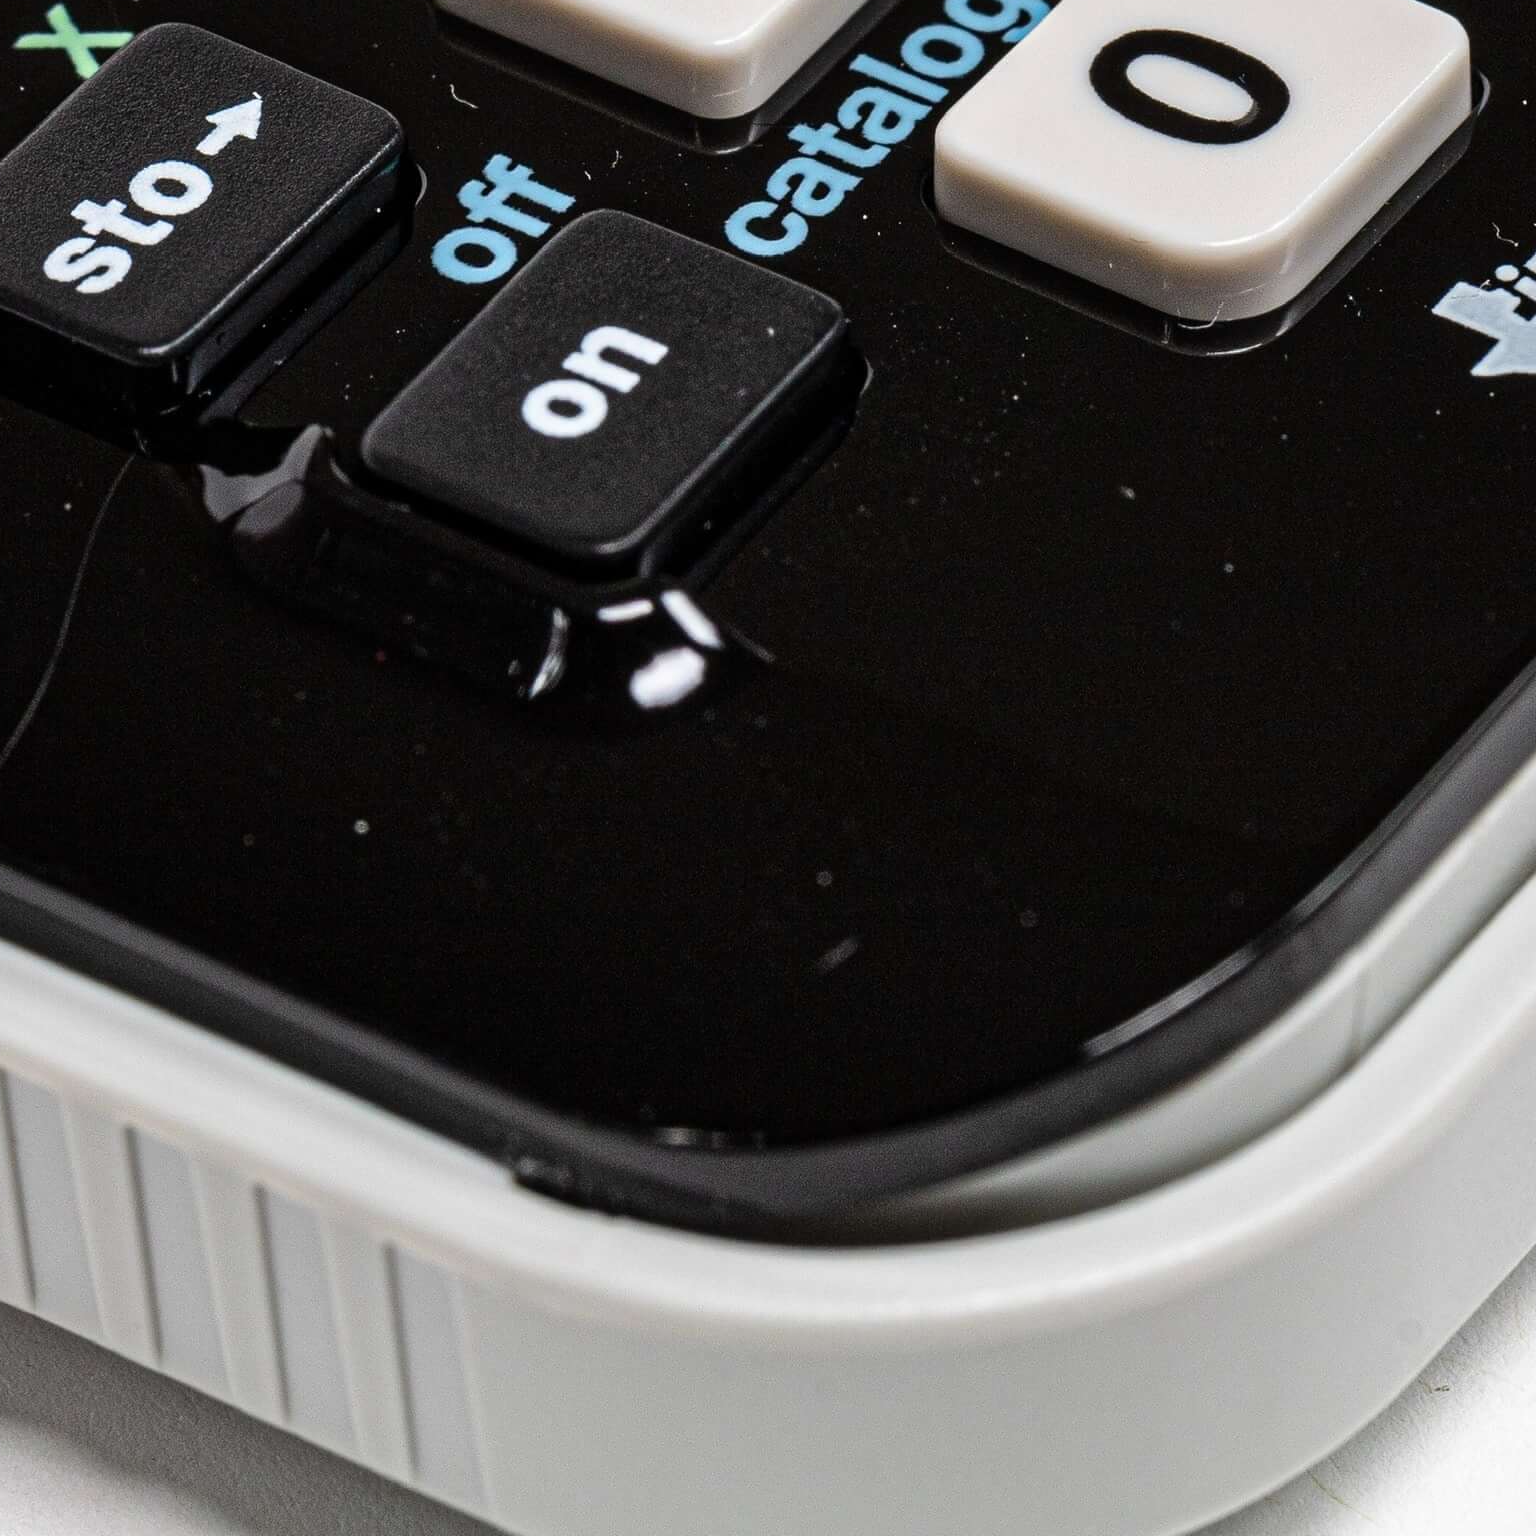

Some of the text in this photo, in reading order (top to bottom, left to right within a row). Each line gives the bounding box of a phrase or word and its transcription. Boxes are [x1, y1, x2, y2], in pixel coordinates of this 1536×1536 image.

[19, 8, 129, 78] X
[1089, 29, 1290, 145] 0
[432, 154, 573, 283] off
[522, 326, 667, 437] on
